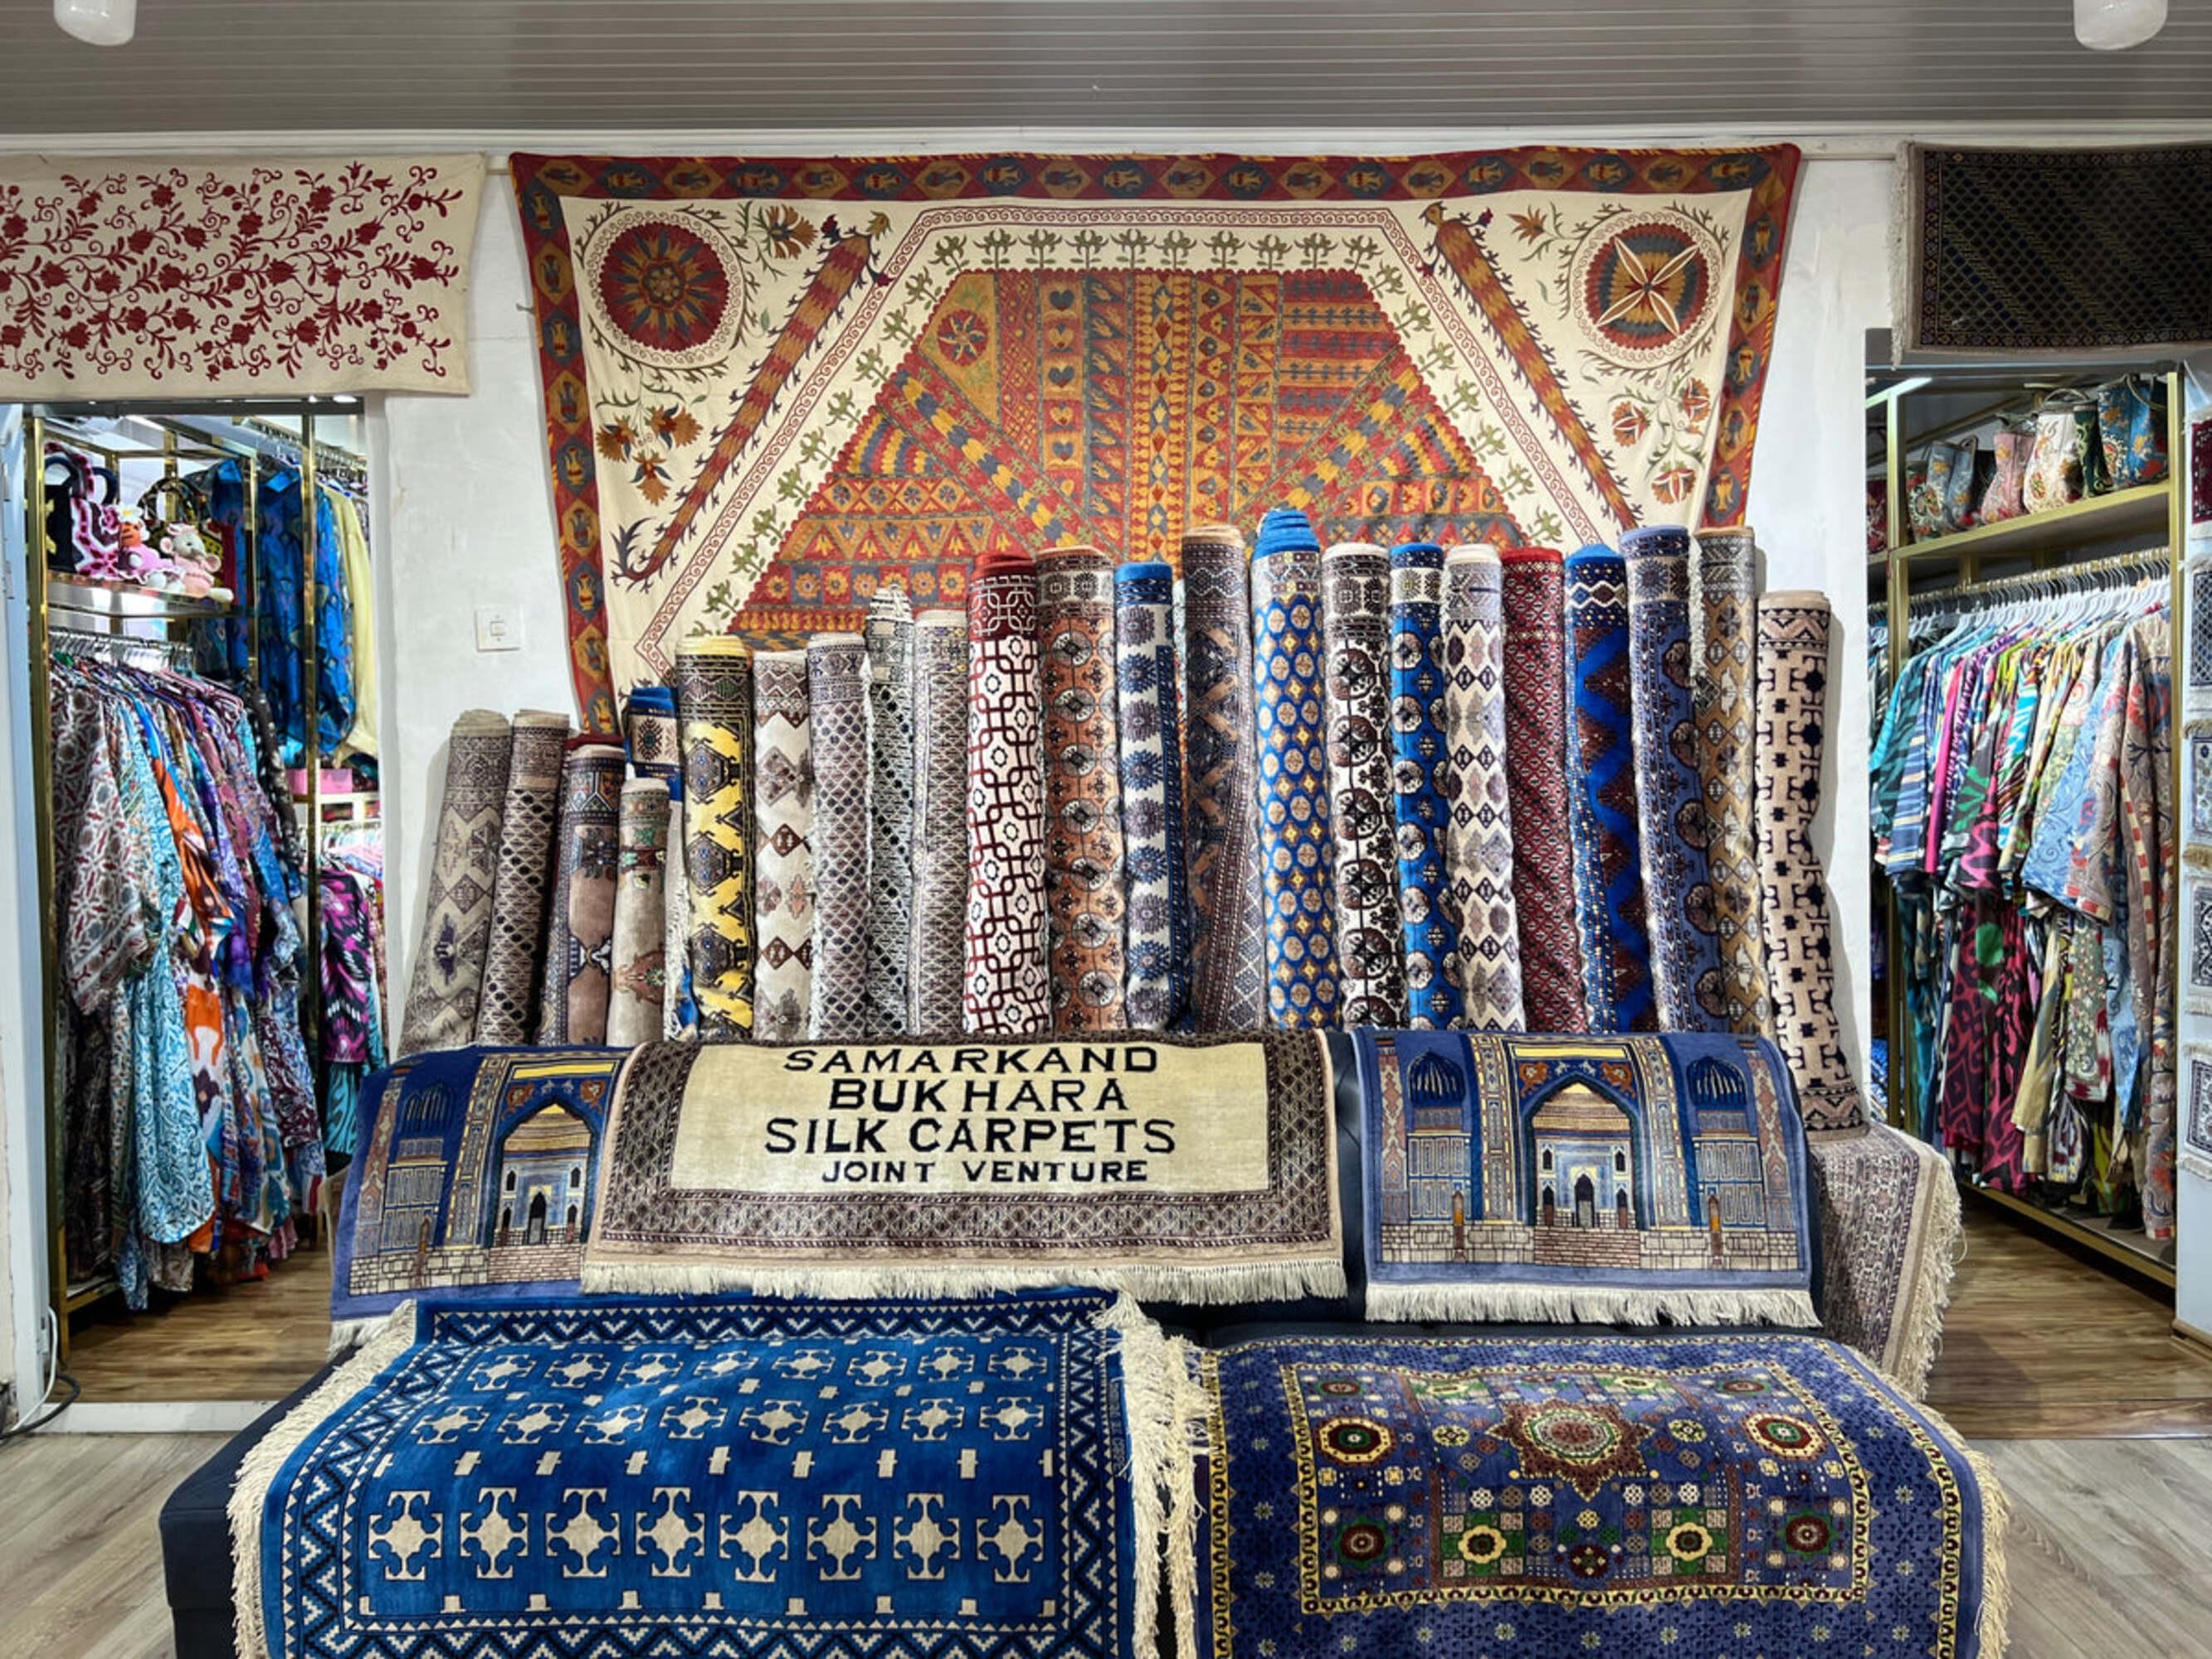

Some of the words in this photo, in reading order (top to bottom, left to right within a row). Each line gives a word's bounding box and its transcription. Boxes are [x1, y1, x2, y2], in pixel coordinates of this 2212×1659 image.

[782, 1047, 1157, 1073] SAMARKAND
[830, 1078, 1128, 1112] BUKHARA
[766, 1118, 888, 1153] SILK
[909, 1118, 1176, 1153] CARPETS
[823, 1161, 935, 1182] JOINT
[962, 1160, 1147, 1182] VENTURE
